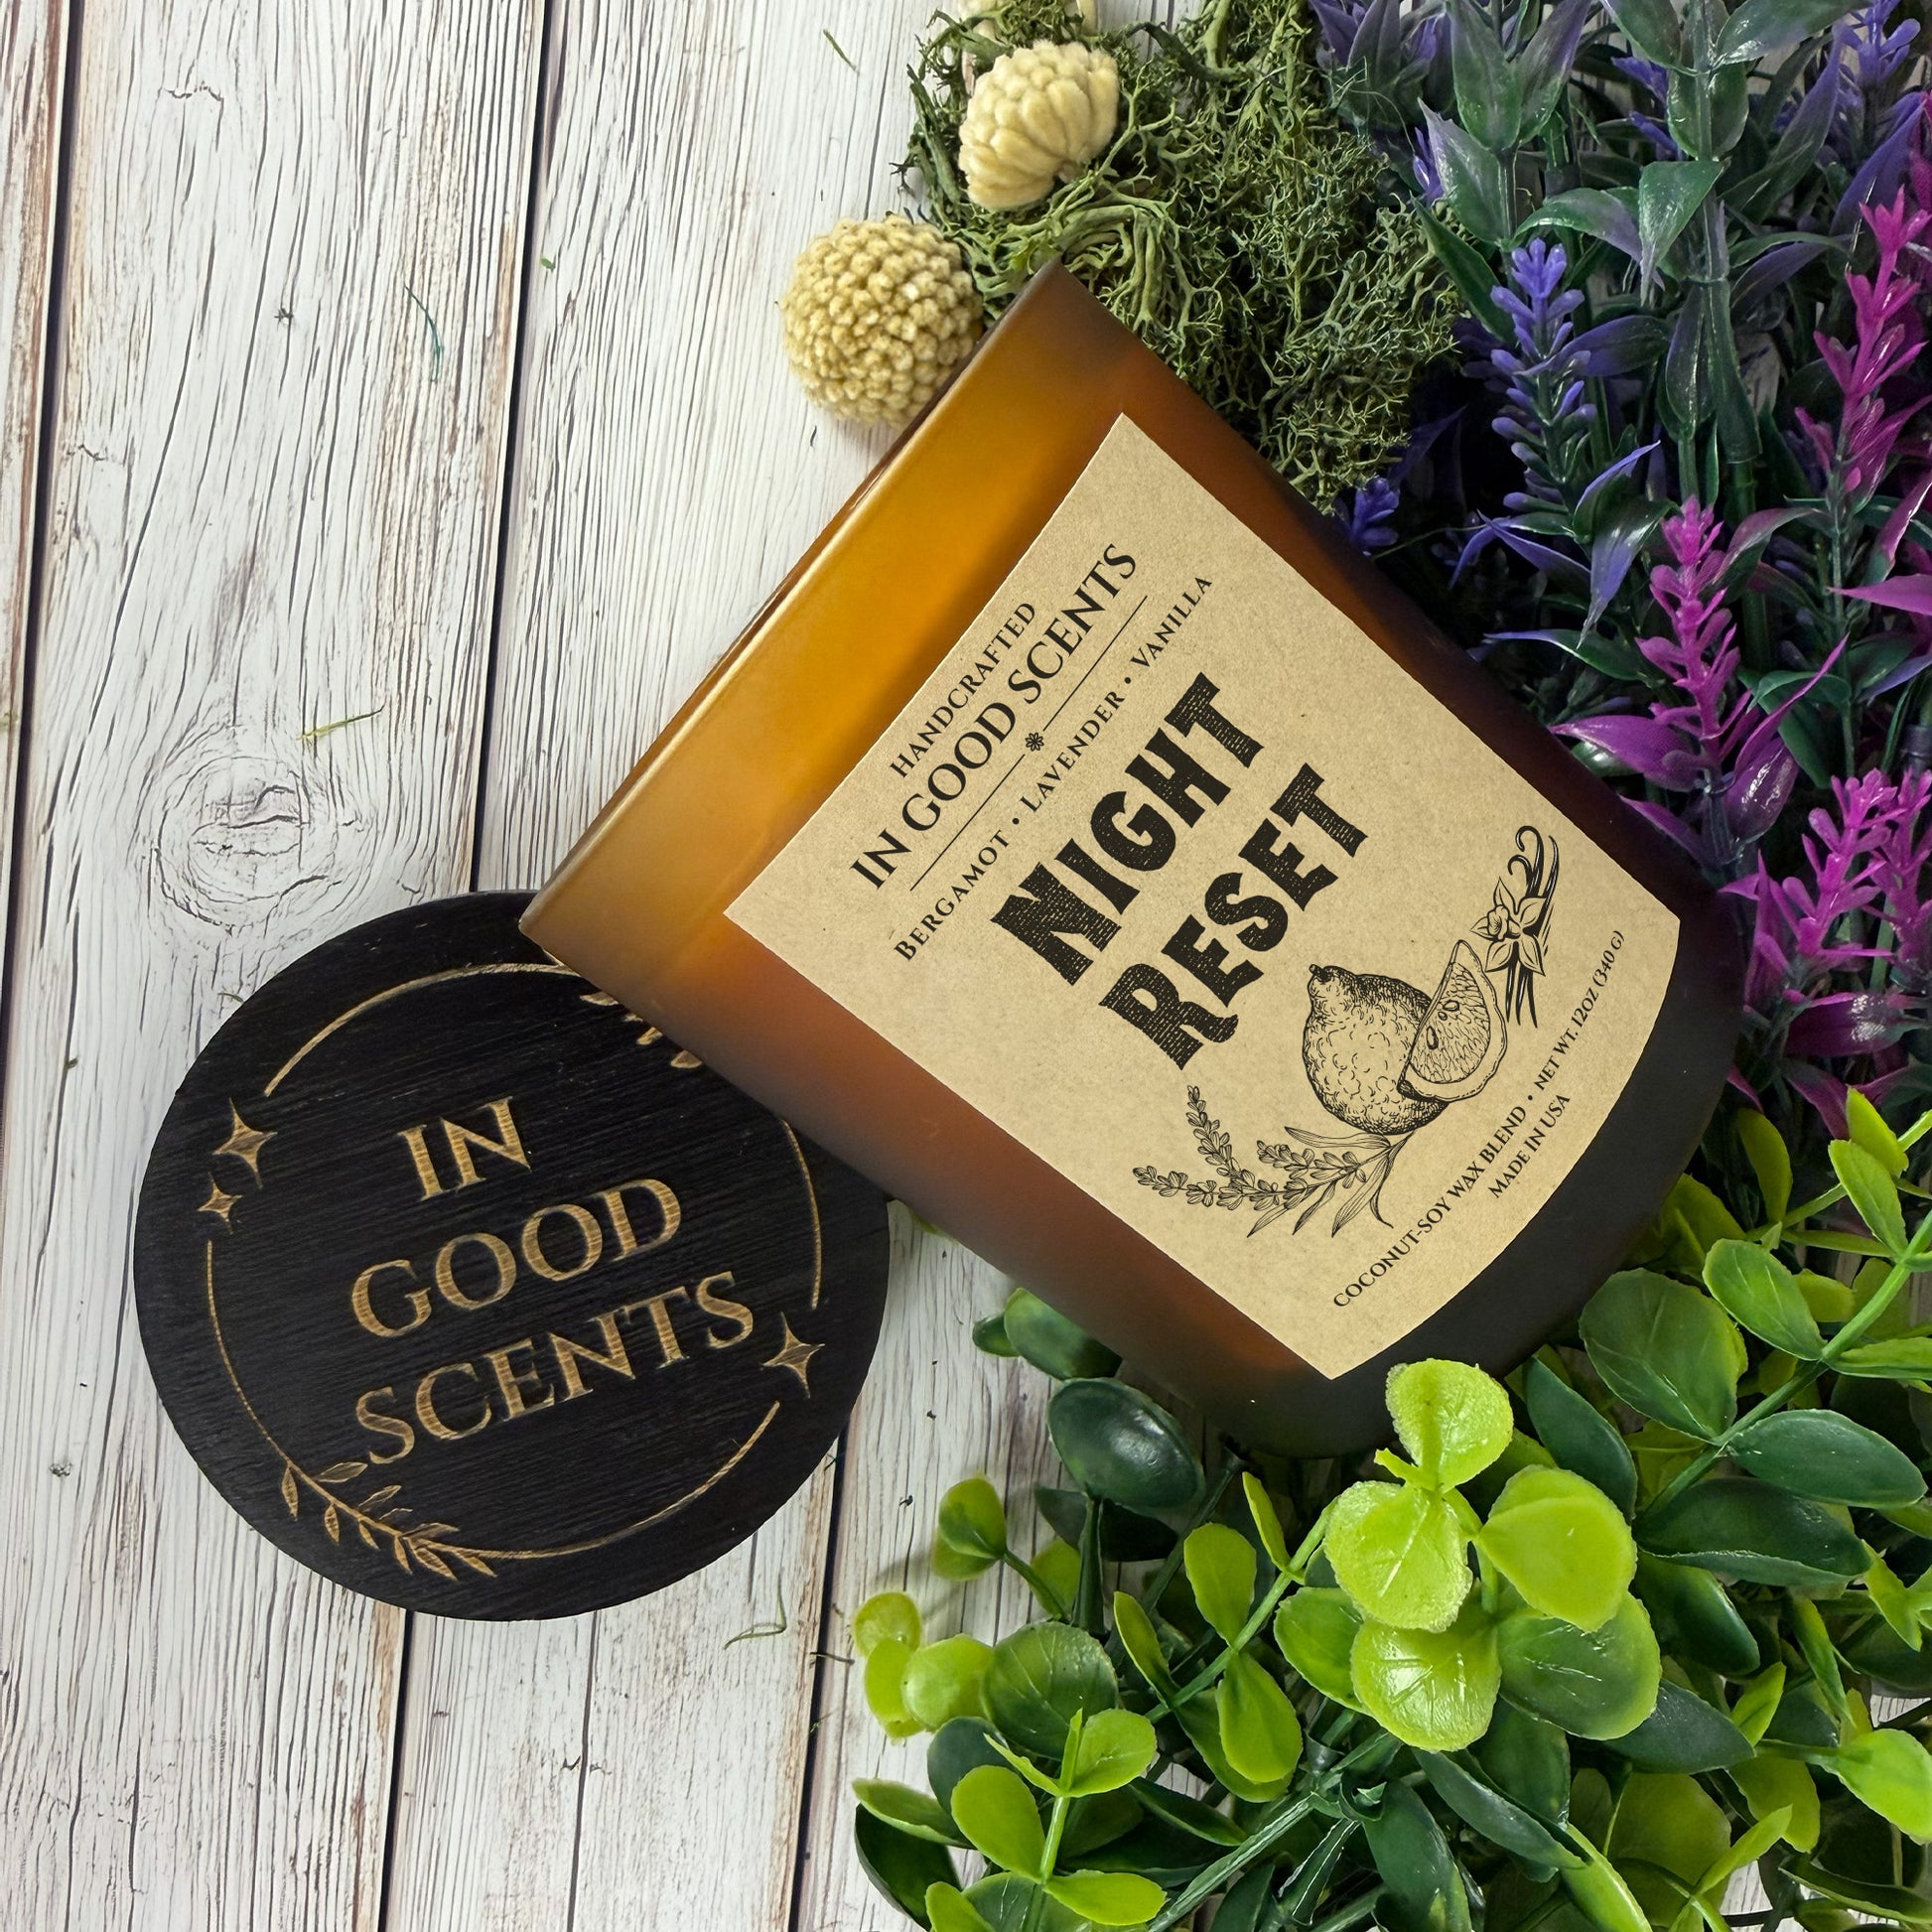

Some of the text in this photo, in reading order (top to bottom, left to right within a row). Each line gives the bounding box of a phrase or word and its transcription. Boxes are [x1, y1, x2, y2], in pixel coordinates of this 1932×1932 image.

[850, 544, 1137, 889] IN GOOD SCENTS
[890, 603, 1035, 778] HANDCRAFTED
[894, 576, 1212, 961] BERGAMOT LAVENDER VANILLA
[991, 672, 1265, 986] NIGHT
[1099, 762, 1368, 1070] RESET
[397, 1096, 531, 1201] IN
[1333, 1196, 1452, 1308] COCONUT-SOY
[1448, 1161, 1486, 1201] WAX
[1479, 1105, 1527, 1164] BLEND
[1534, 1054, 1561, 1091] NET
[1553, 1028, 1579, 1055] WT.
[1591, 949, 1615, 988] (340
[1487, 1094, 1571, 1198] MADE IN USA
[351, 1178, 681, 1337] GOOD
[355, 1272, 754, 1464] SCENTS
